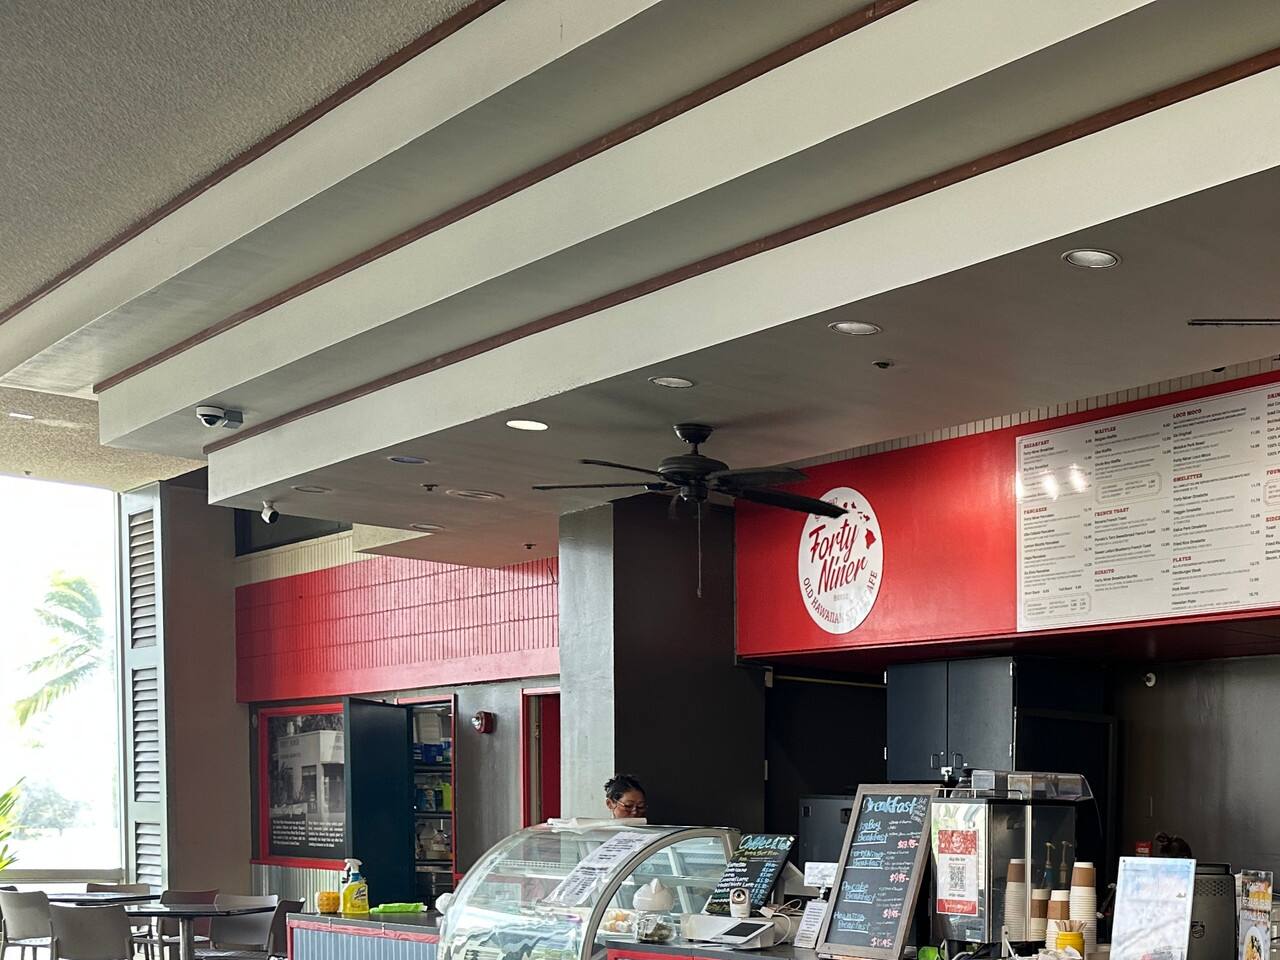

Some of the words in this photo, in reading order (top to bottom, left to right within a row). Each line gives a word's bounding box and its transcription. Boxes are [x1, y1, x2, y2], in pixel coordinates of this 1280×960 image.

[809, 519, 858, 563] Forty
[803, 577, 814, 599] OLD
[817, 556, 868, 595] Niner
